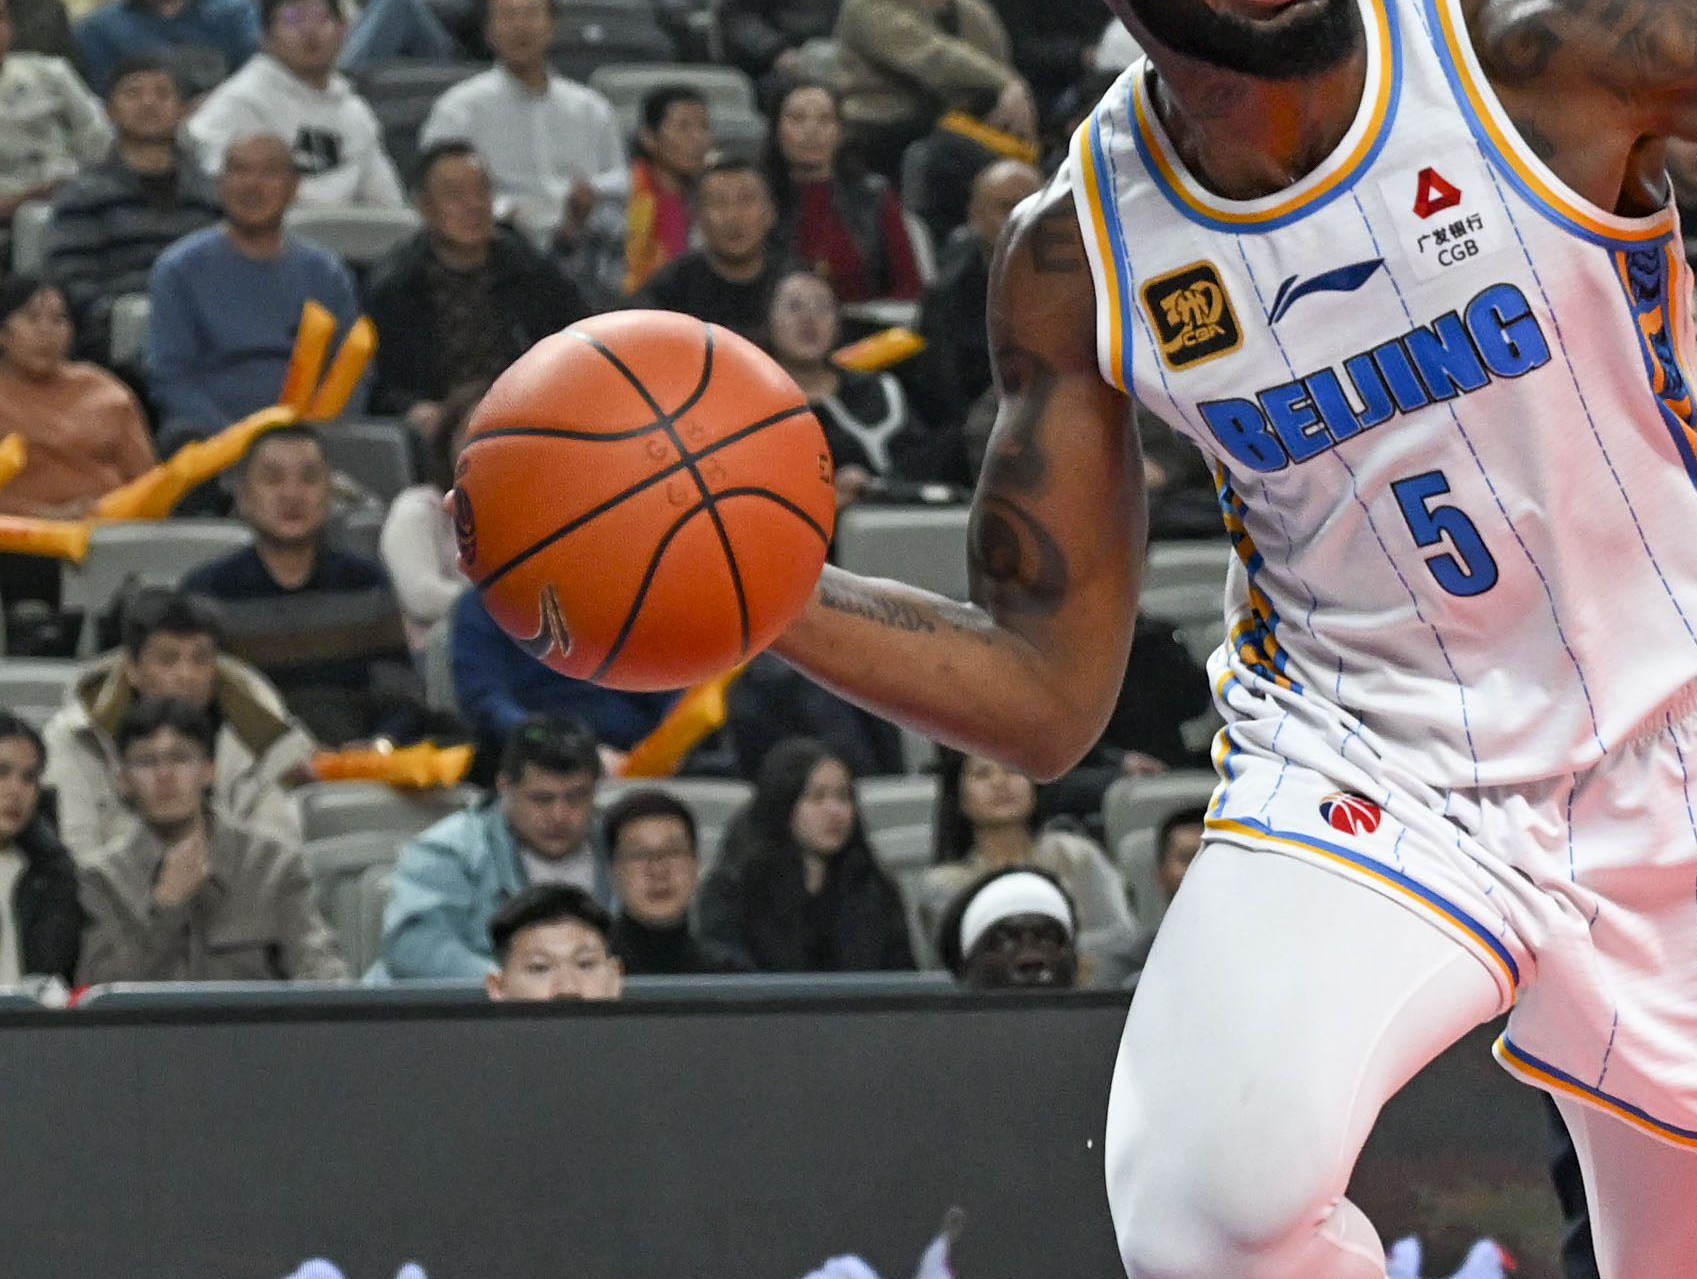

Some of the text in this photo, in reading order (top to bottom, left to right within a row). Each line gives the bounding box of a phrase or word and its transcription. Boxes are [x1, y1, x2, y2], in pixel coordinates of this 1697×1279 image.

[1417, 212, 1484, 254] 广发银行
[1437, 239, 1480, 267] CGB
[1197, 282, 1552, 473] BEIJING
[1390, 470, 1499, 597] 5
